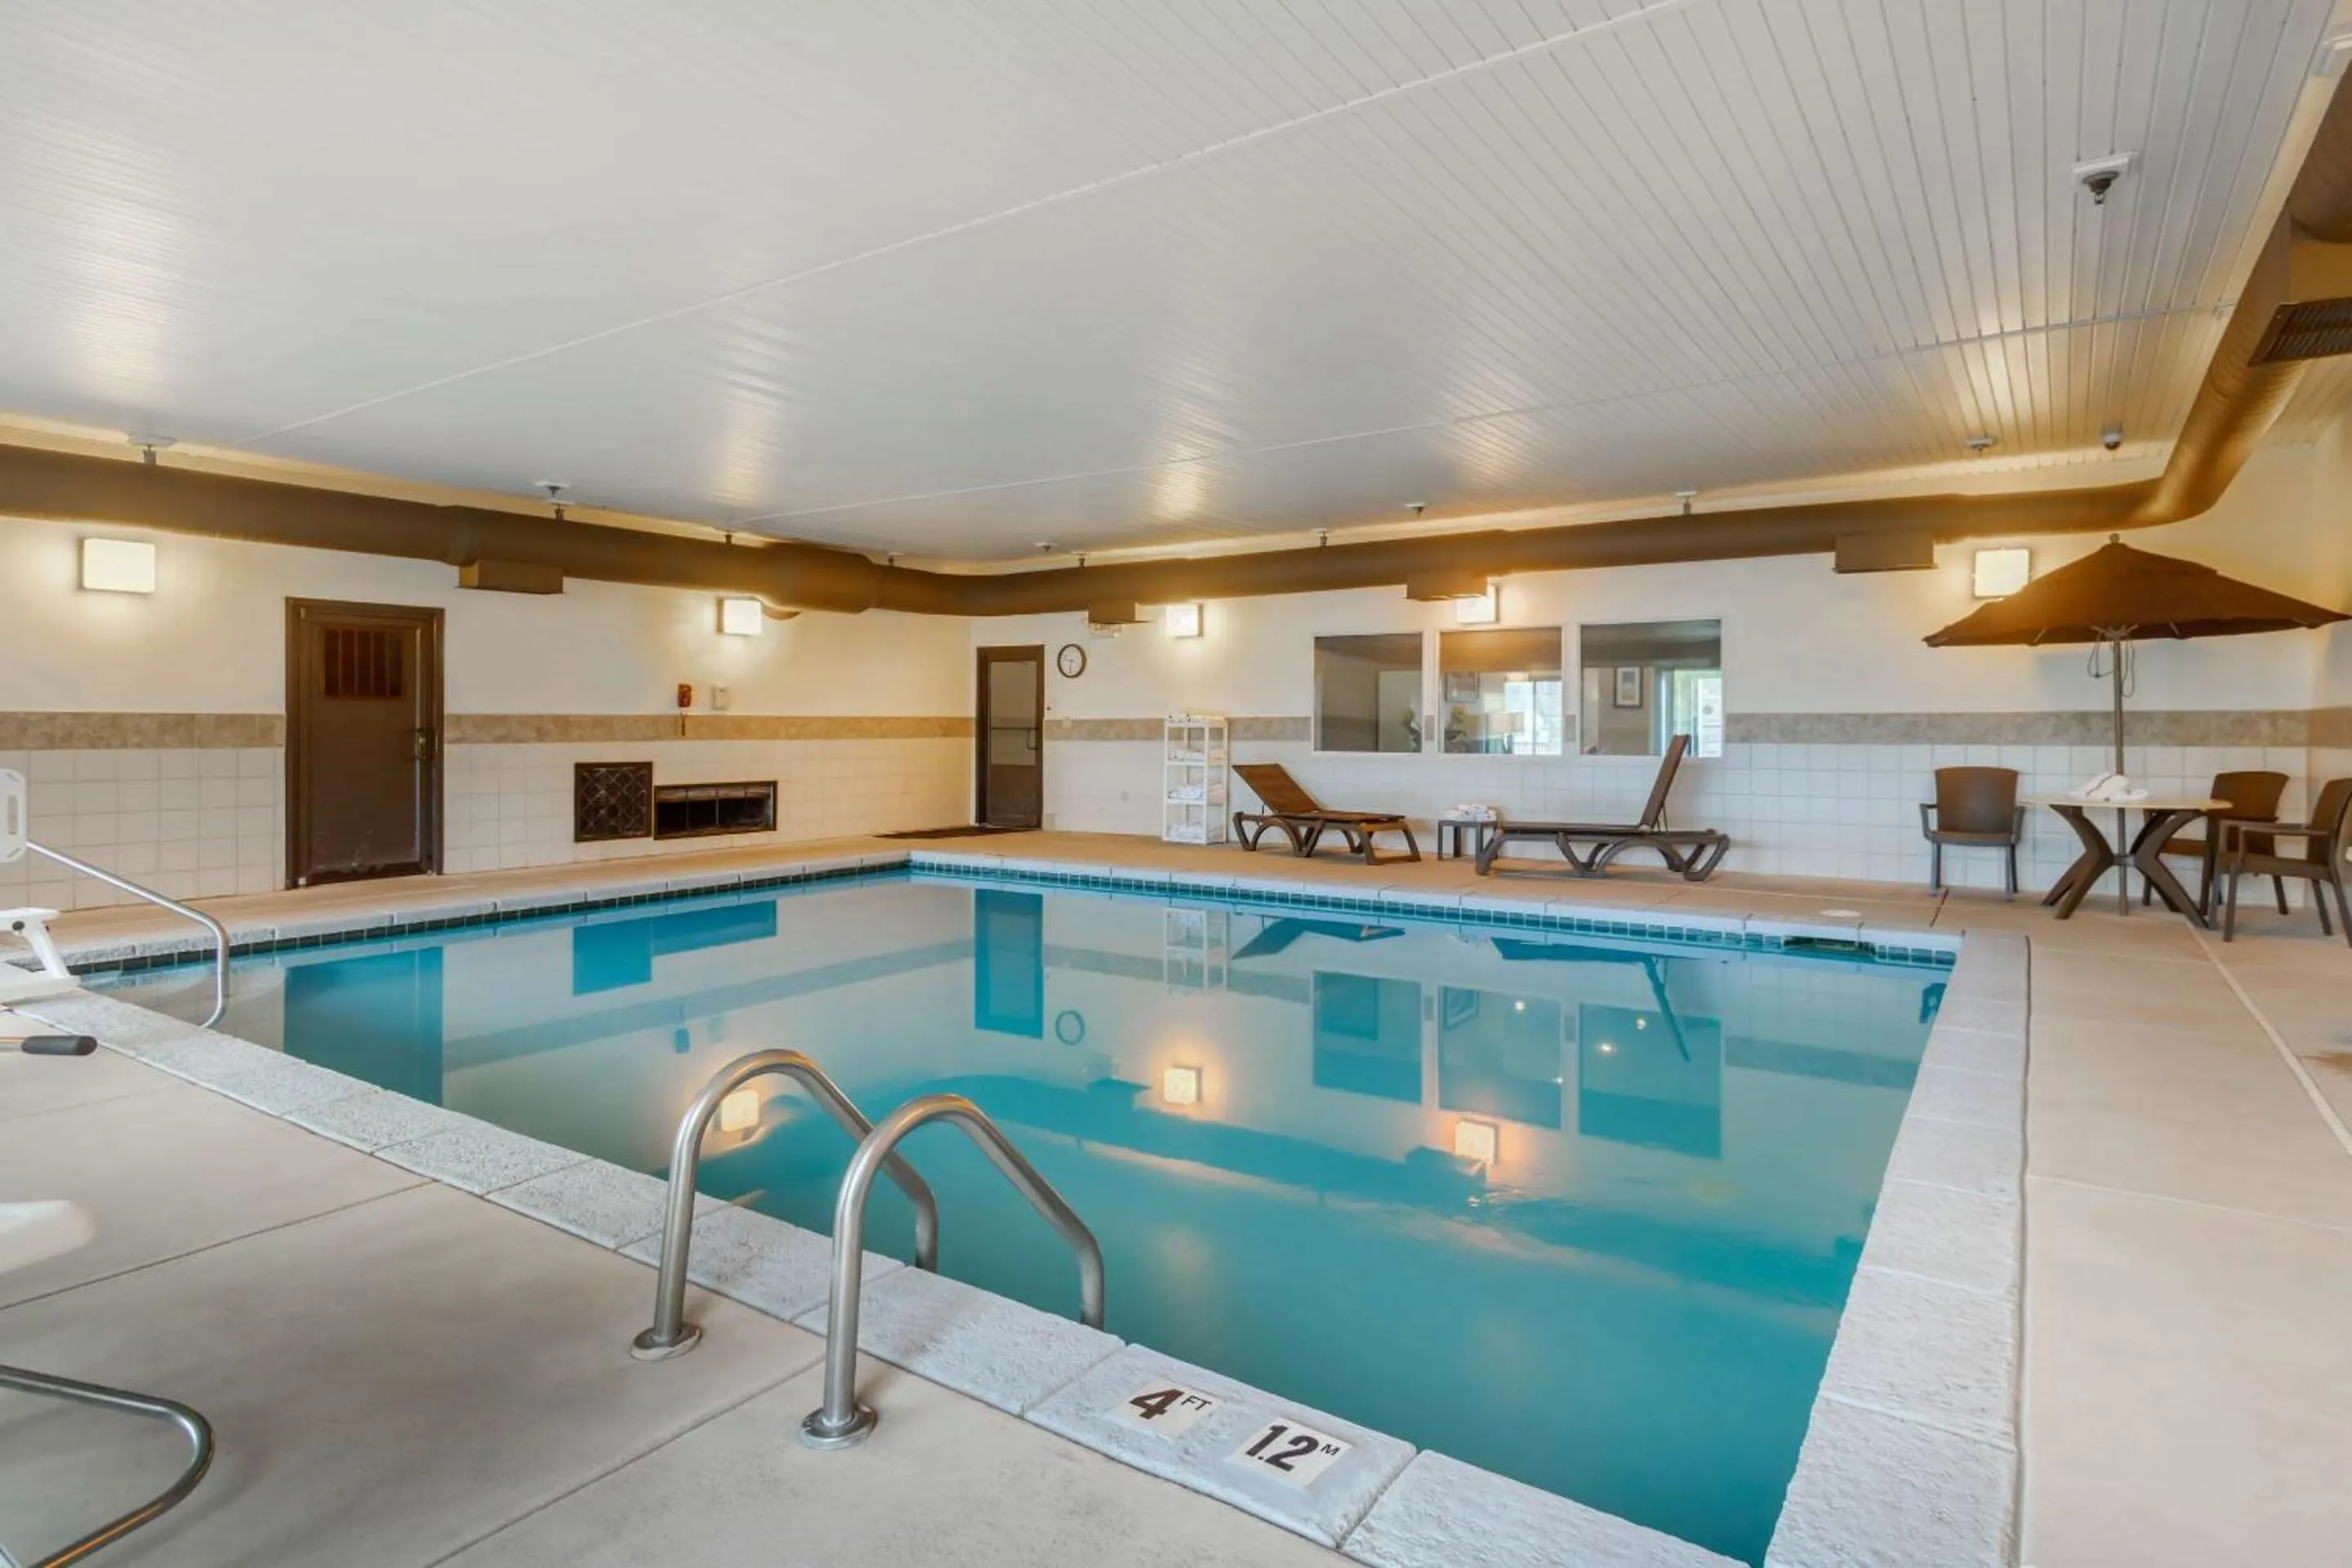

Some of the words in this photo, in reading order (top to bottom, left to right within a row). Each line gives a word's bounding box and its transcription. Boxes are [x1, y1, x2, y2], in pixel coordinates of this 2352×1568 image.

[1129, 1388, 1184, 1419] 4
[1181, 1395, 1212, 1410] FT
[1245, 1425, 1320, 1472] 1.2
[1320, 1444, 1340, 1455] M
